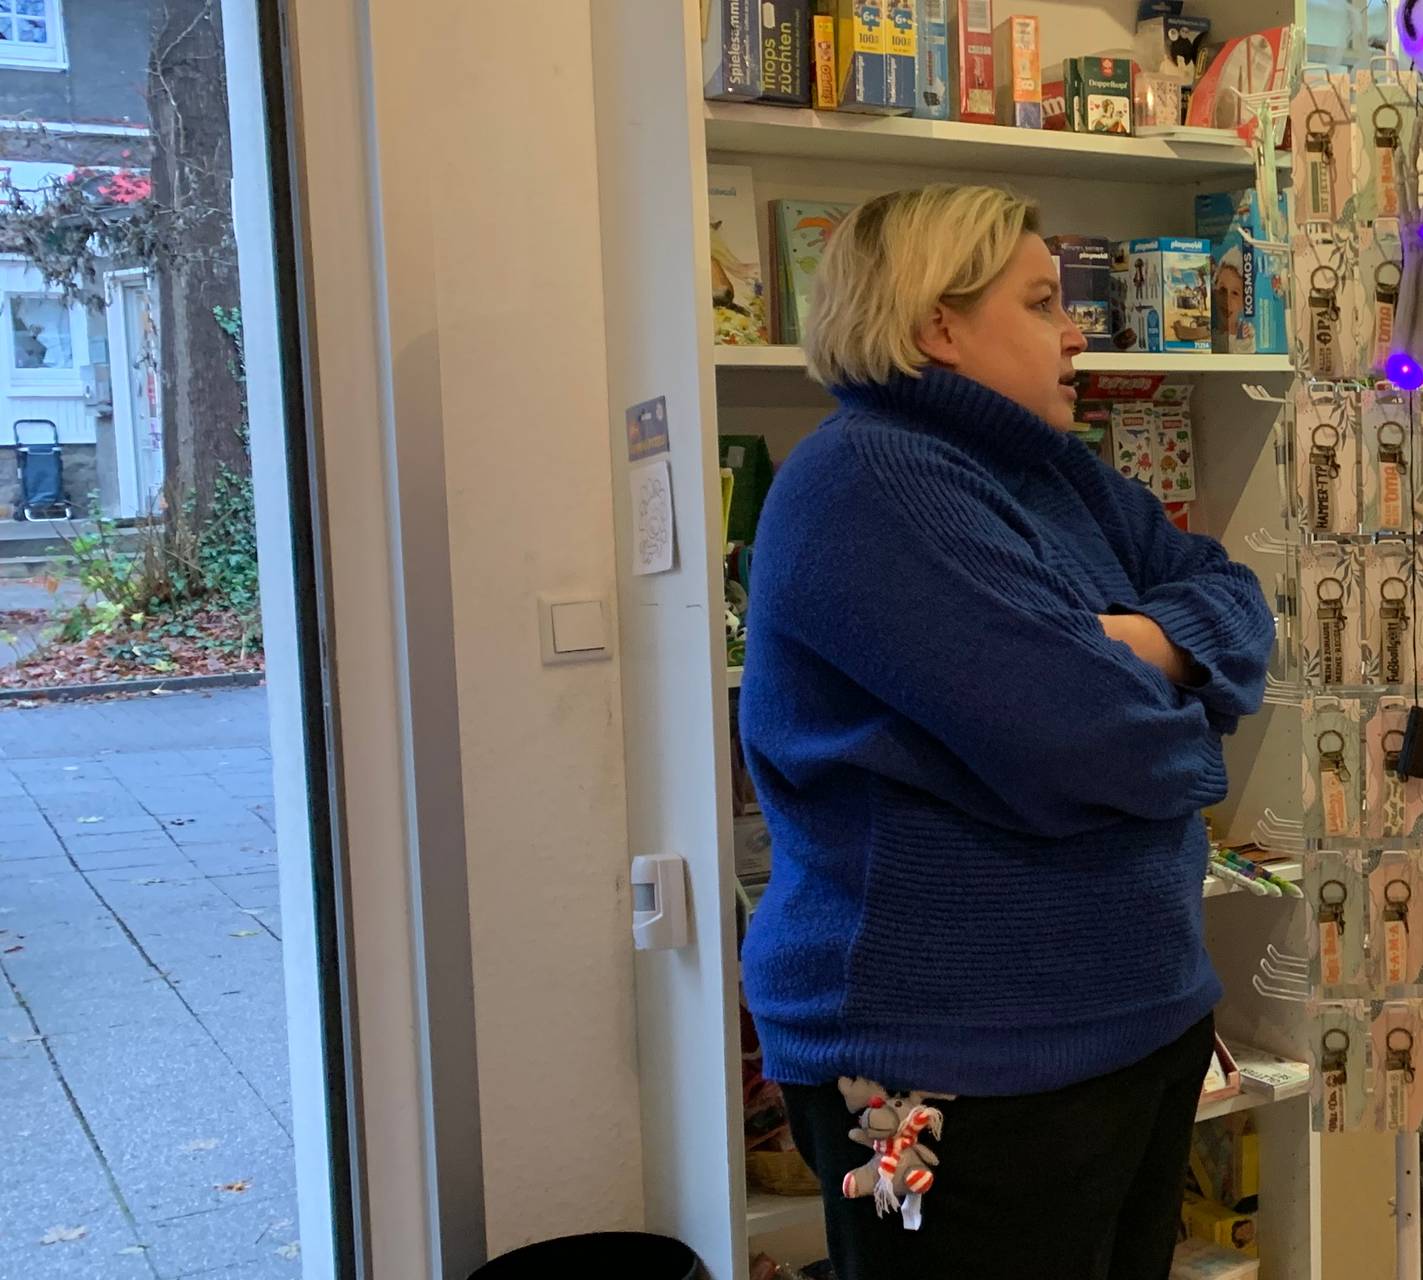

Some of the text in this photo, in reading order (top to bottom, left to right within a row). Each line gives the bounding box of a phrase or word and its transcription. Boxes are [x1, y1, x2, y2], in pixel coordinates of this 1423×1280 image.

[764, 38, 778, 90] Triops
[781, 22, 793, 94] züchten
[1244, 252, 1253, 316] KOSMOS
